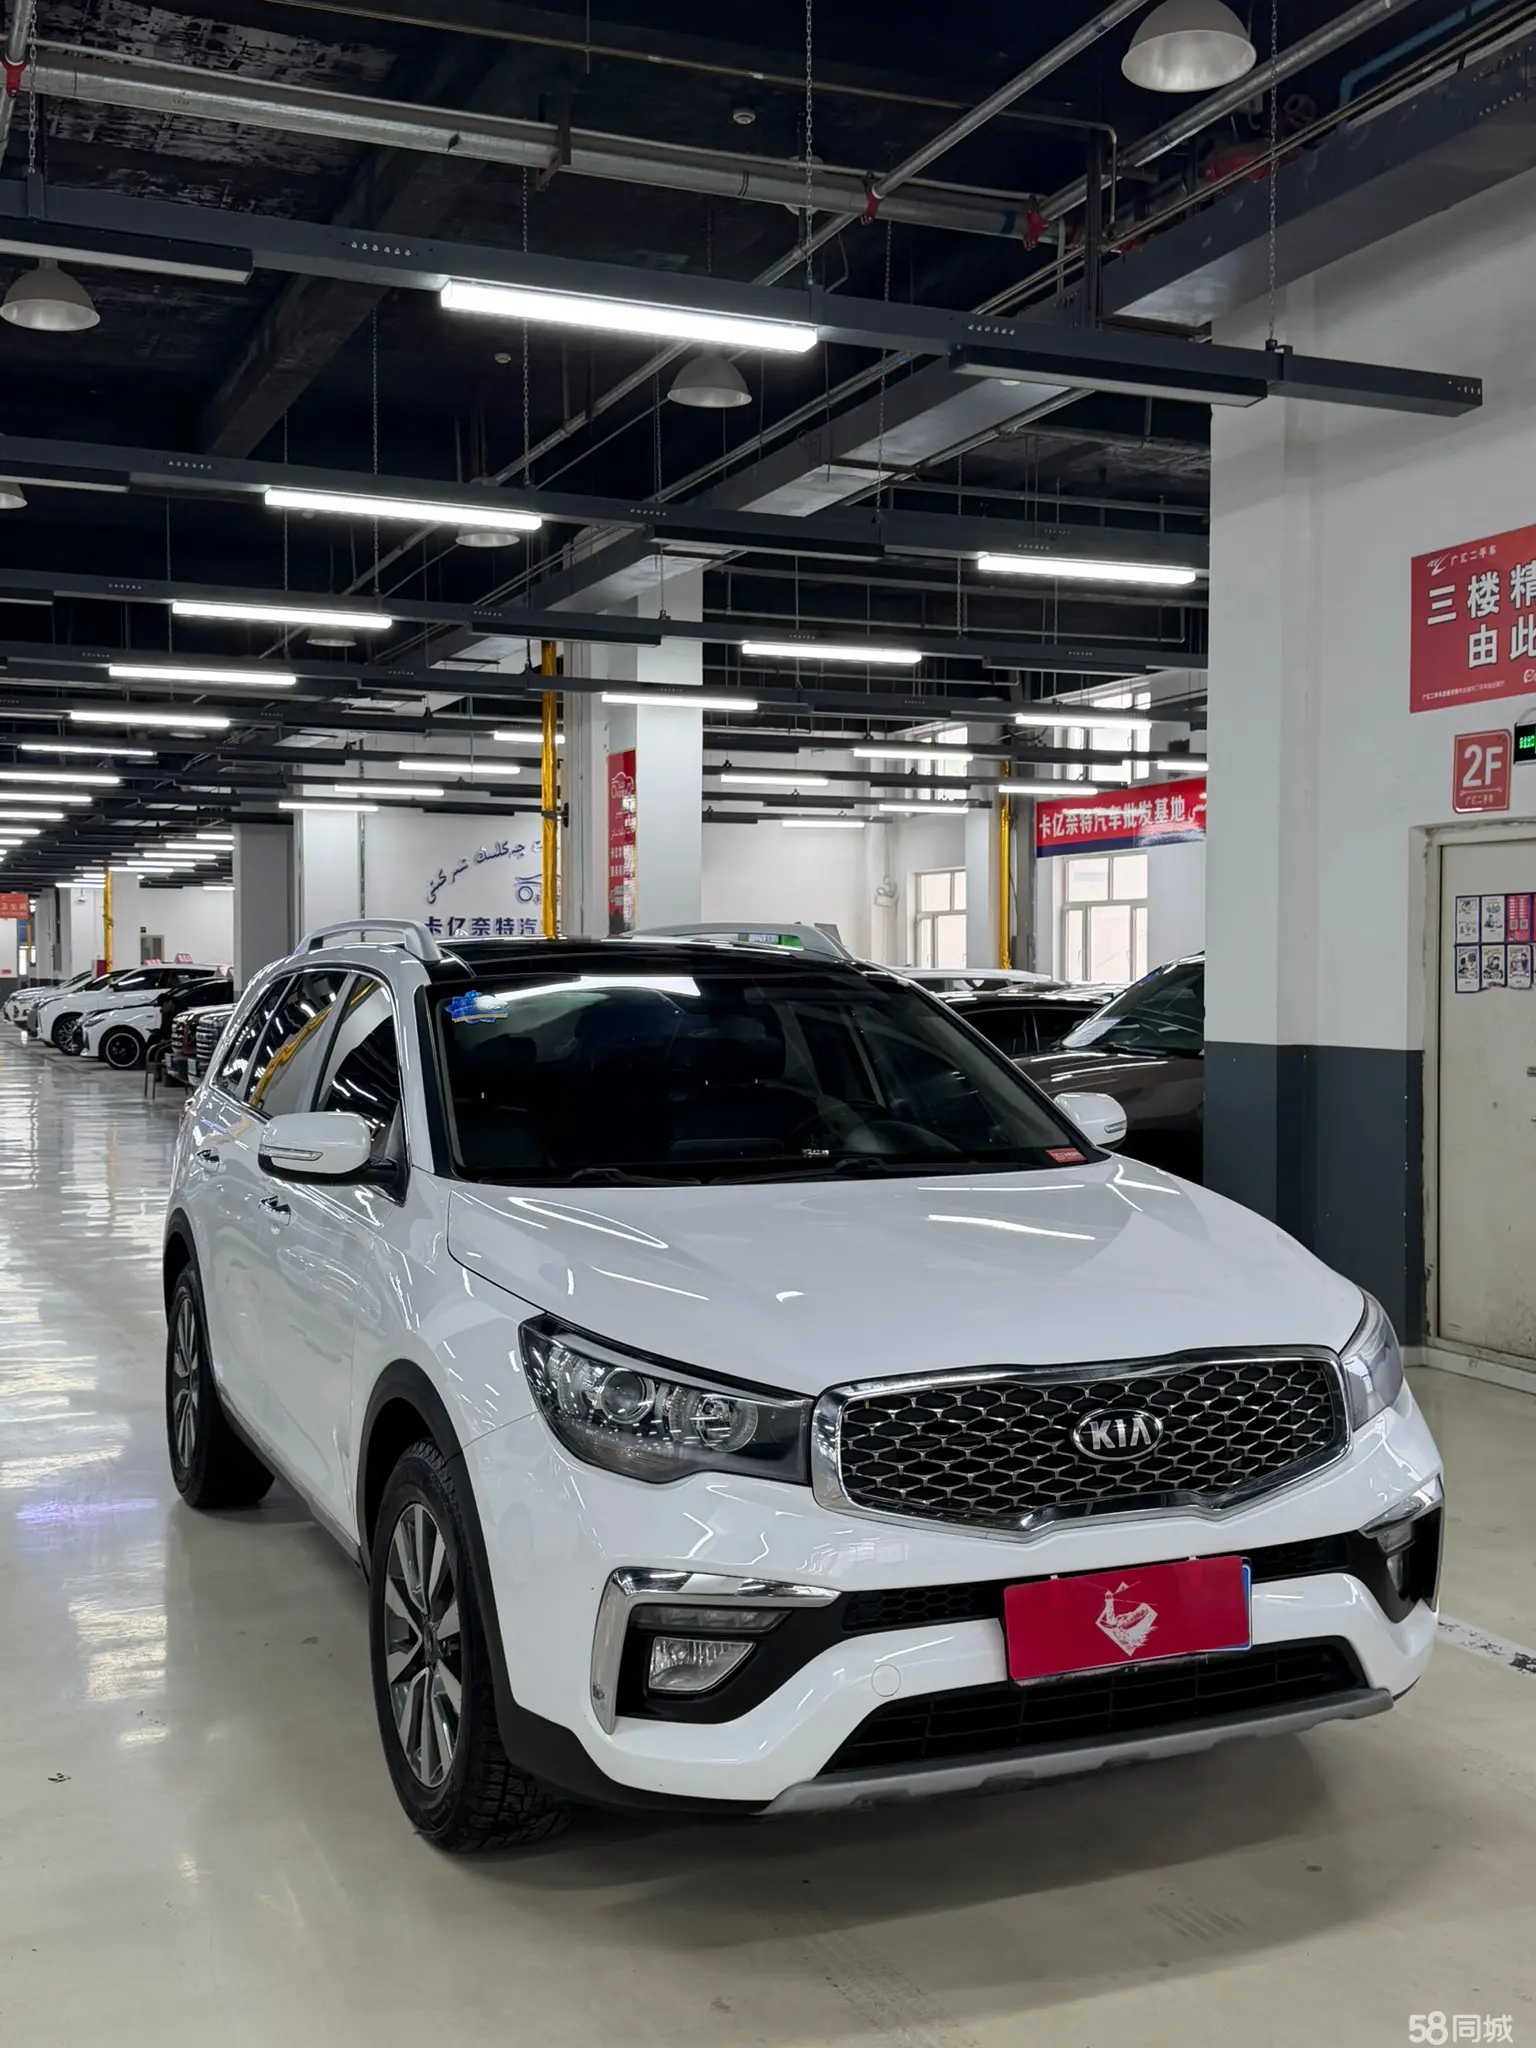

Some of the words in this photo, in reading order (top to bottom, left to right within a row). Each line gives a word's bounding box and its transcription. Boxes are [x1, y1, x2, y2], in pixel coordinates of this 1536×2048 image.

[1450, 545, 1497, 567] 广汇二手车
[1427, 560, 1536, 625] 三楼精
[1468, 613, 1536, 668] 由此
[1463, 744, 1503, 787] 2F
[1039, 795, 1186, 840] 卡亿奈特汽车批发基地
[1089, 1418, 1152, 1449] KIA
